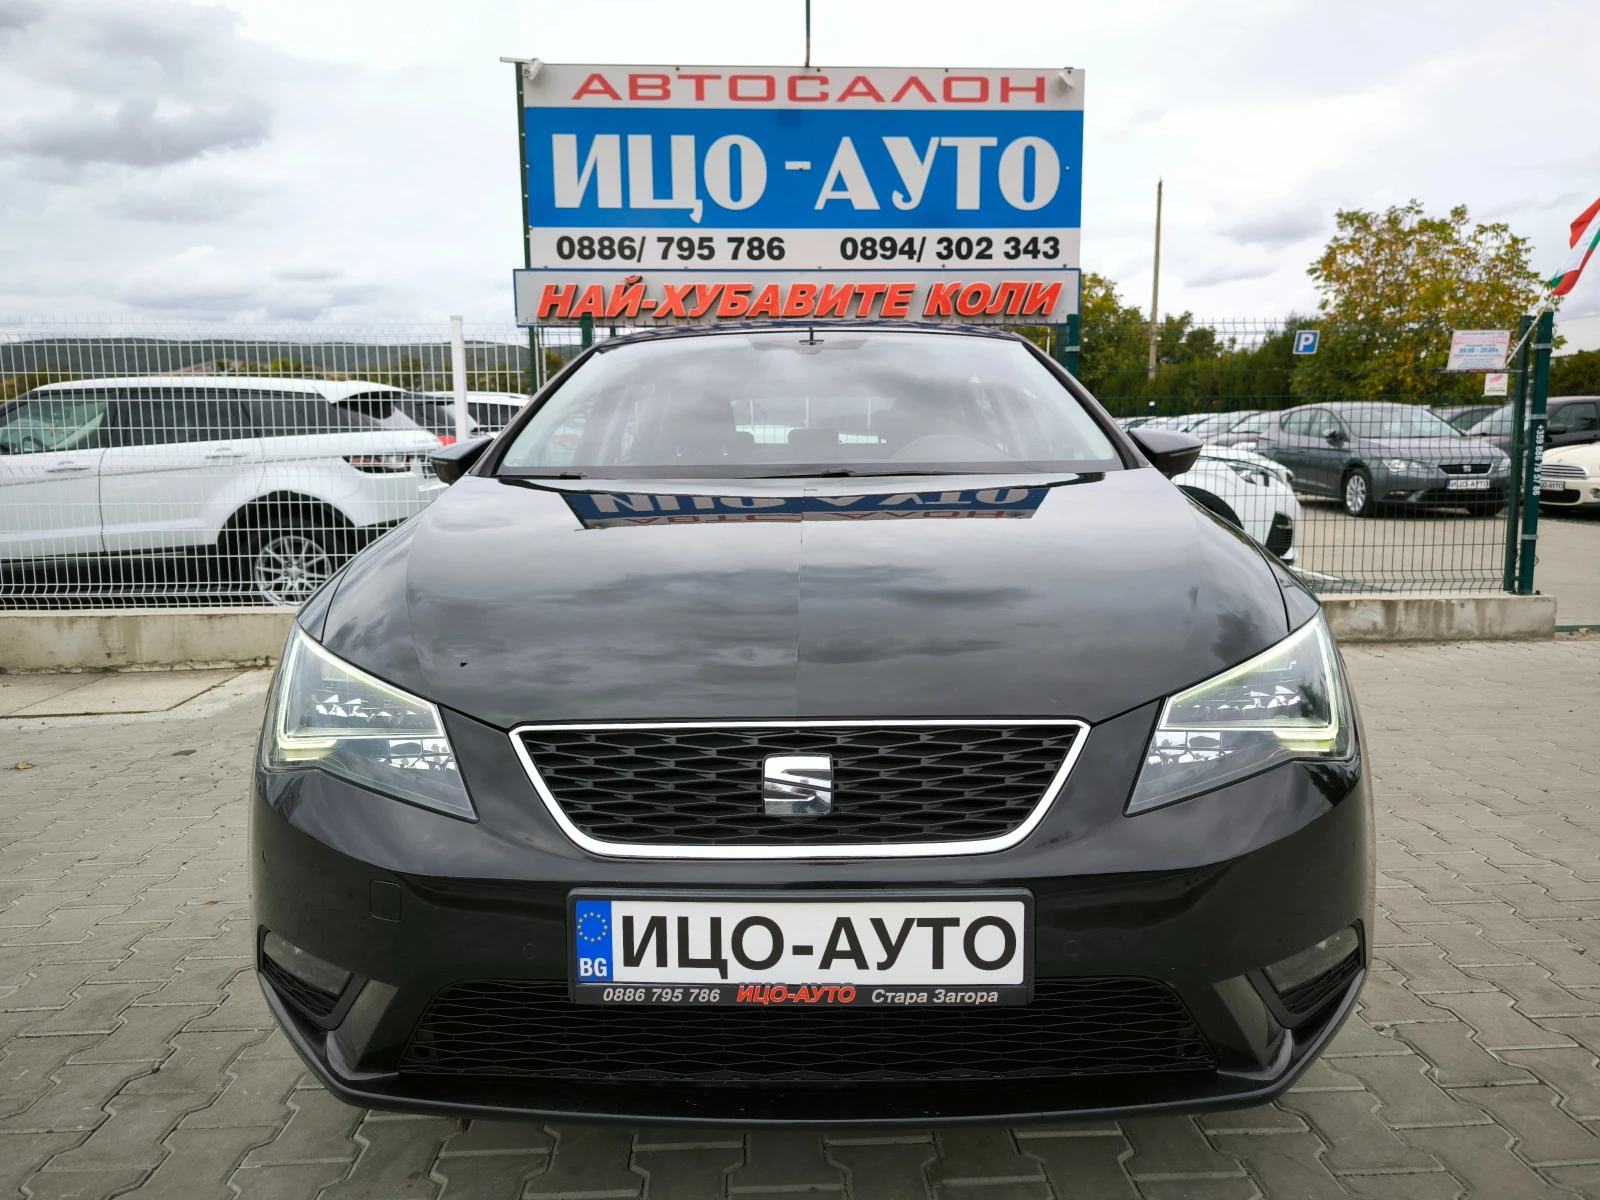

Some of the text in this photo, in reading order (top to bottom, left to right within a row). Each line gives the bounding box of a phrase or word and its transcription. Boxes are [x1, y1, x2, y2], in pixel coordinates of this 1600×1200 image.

[572, 73, 1046, 103] АВТОСАЛОН
[556, 235, 785, 262] 0886/ 795 786
[839, 235, 1061, 262] 0894/ 302 343
[536, 275, 1064, 319] НАЙ-ХУБАВИТЕ КОЛИ
[1298, 334, 1314, 351] P
[1536, 424, 1545, 444] +359
[1534, 445, 1543, 461] 886
[1534, 462, 1542, 472] 79
[1533, 474, 1541, 483] 57
[621, 915, 1018, 980] ИЦО-АУТО
[579, 957, 608, 977] BG
[602, 988, 721, 1002] 0886 795 786
[736, 983, 857, 1005] ИЦО-АУТО
[871, 988, 999, 1004] Стара Загора
